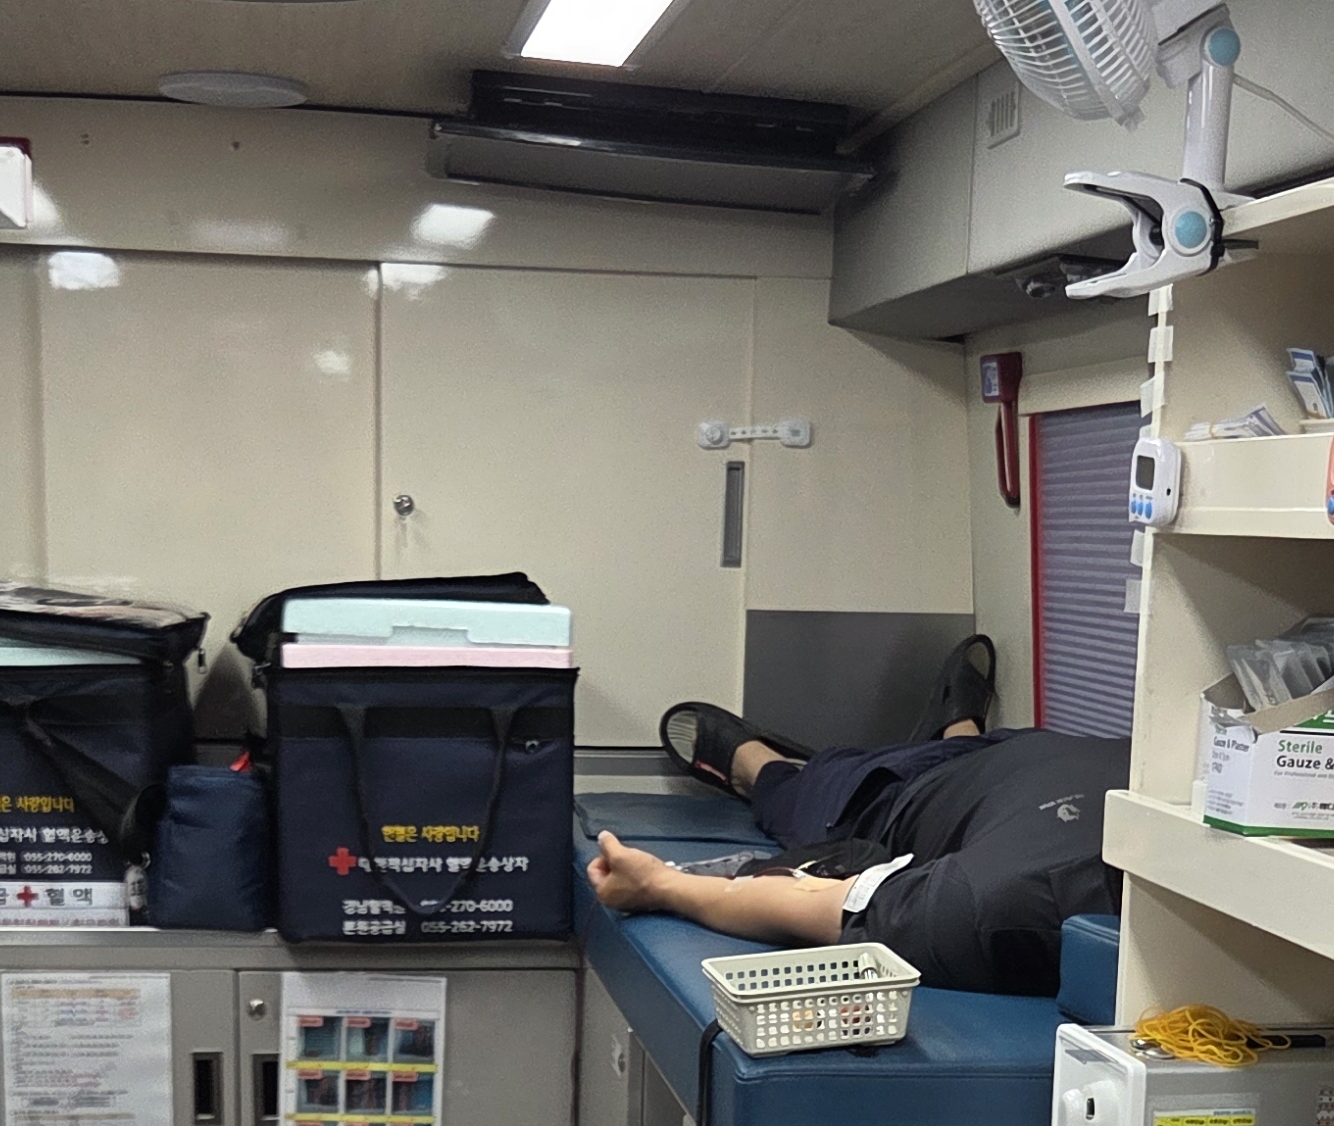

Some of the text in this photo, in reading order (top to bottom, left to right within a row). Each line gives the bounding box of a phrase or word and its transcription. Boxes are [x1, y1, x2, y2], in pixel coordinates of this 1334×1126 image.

[1278, 739, 1323, 755] Sterile
[1276, 755, 1322, 770] Gauze
[45, 887, 93, 906] 혈액
